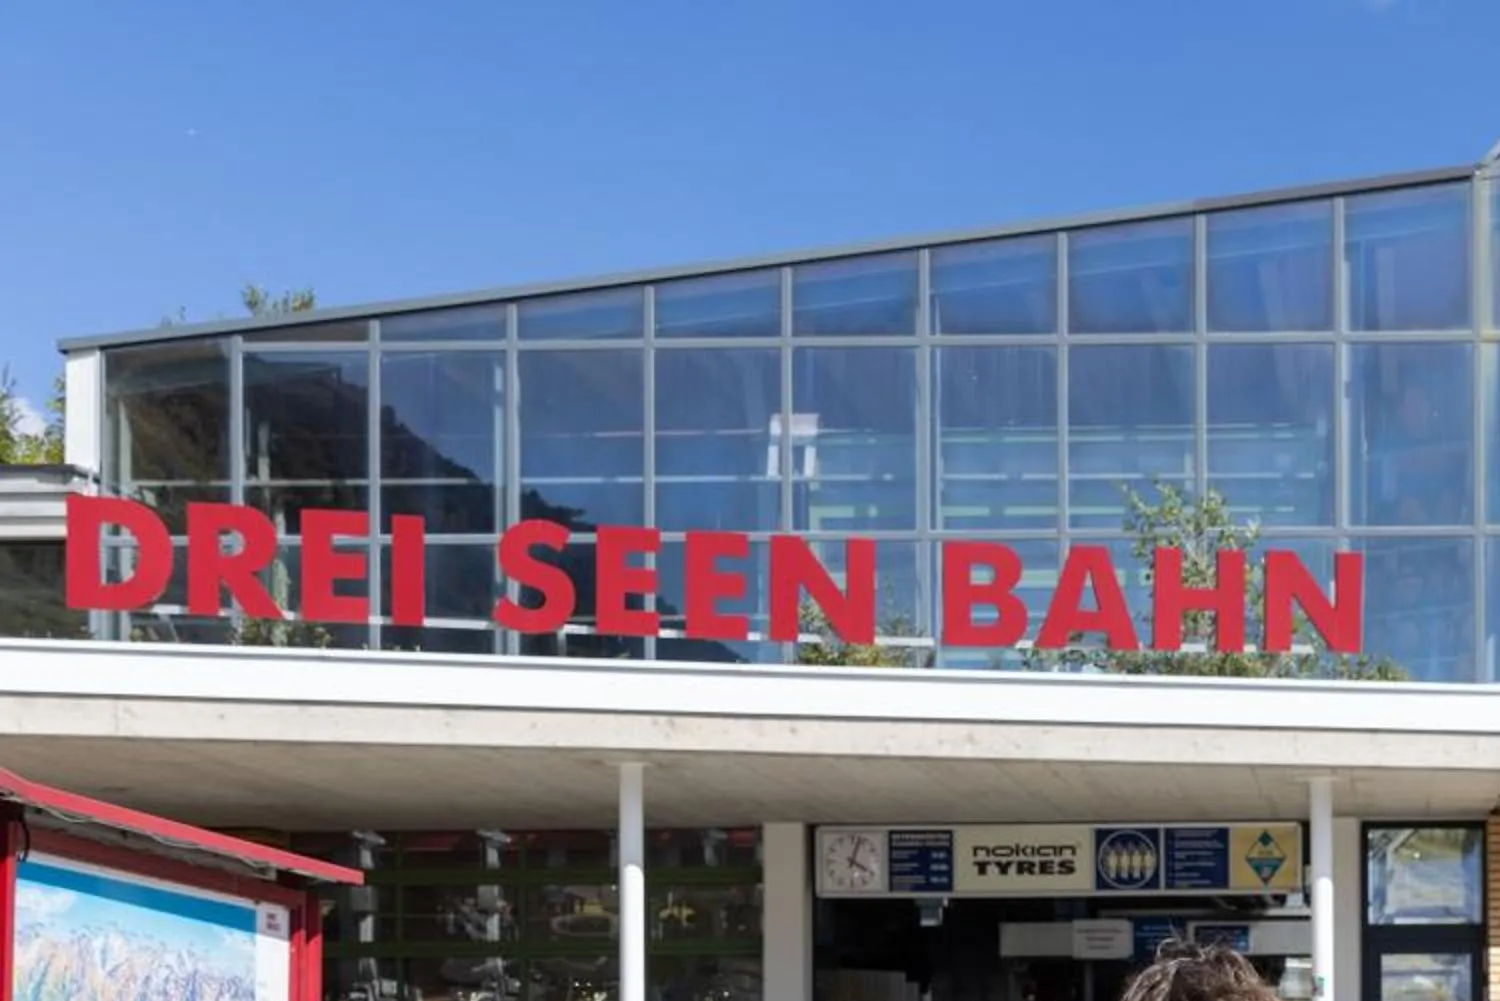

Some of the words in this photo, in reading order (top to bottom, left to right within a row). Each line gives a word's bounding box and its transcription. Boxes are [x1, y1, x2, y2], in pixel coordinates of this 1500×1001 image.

[66, 495, 425, 627] DREI
[493, 518, 876, 646] SEEN
[941, 540, 1364, 654] BAHN
[973, 860, 1076, 876] TYRES
